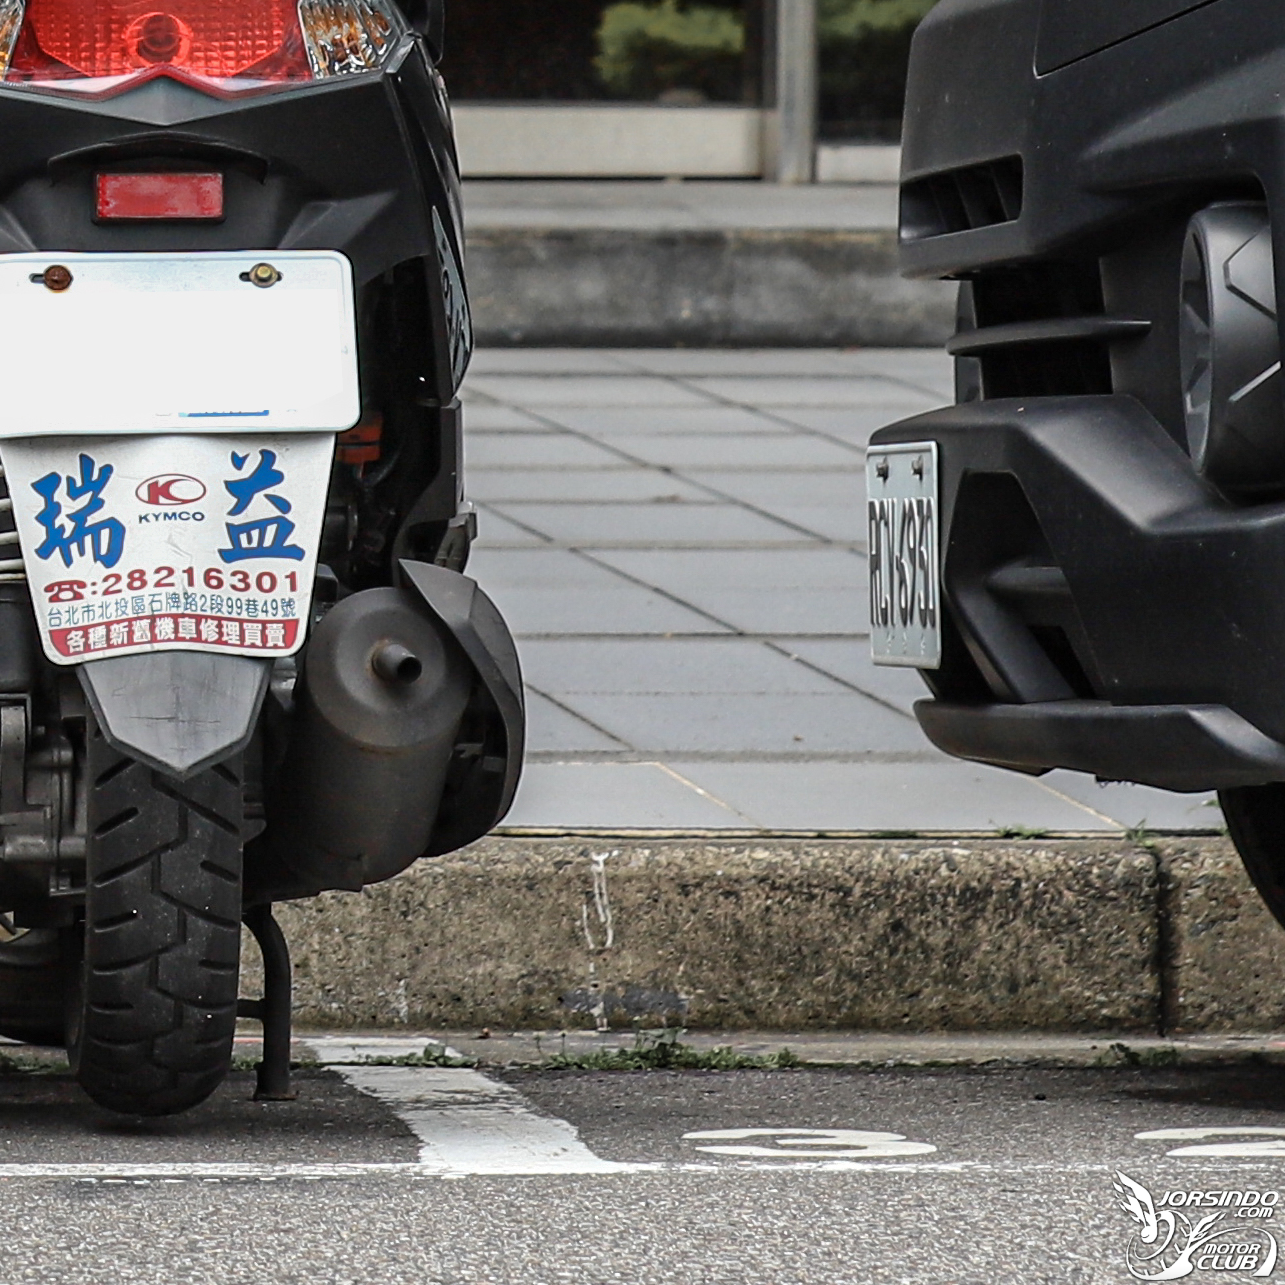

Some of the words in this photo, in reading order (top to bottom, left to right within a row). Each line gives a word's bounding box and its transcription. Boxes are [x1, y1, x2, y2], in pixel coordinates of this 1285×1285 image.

[31, 452, 126, 569] 瑞
[217, 449, 306, 564] 益
[137, 510, 206, 524] KYMCO
